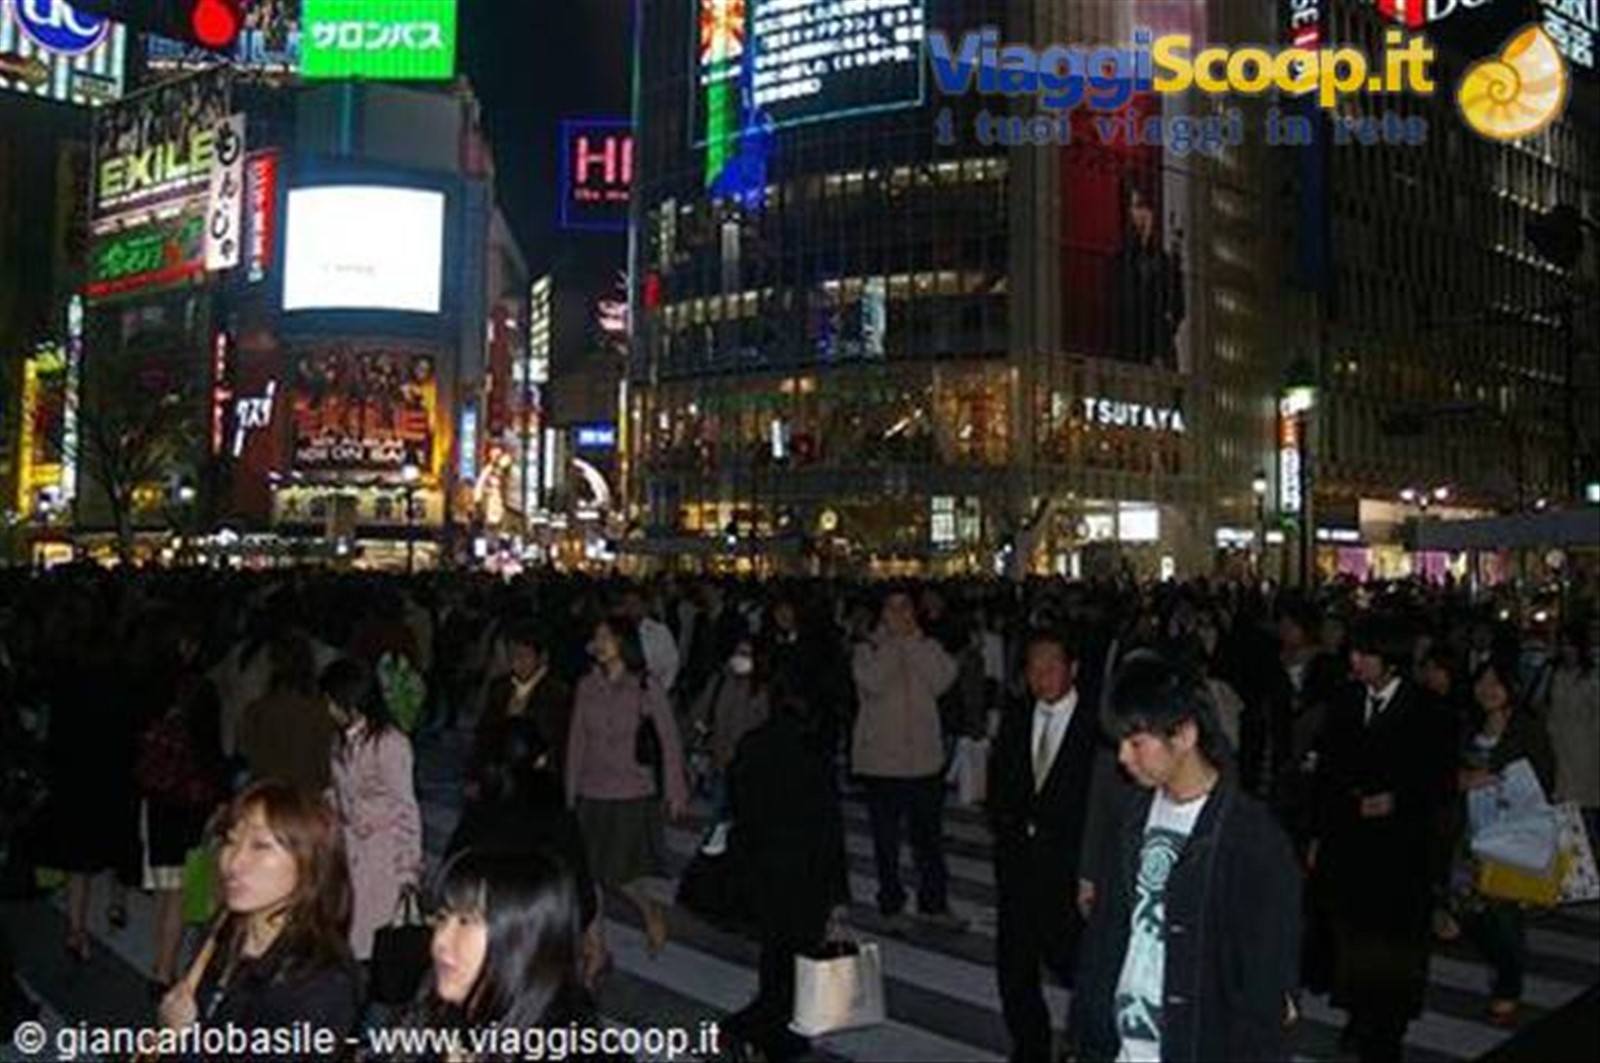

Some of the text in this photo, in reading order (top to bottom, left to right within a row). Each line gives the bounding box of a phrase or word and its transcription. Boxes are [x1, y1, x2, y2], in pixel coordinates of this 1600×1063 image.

[312, 21, 443, 50] サロンパス
[100, 128, 213, 197] EXILE
[1083, 397, 1187, 433] TSUTAYA
